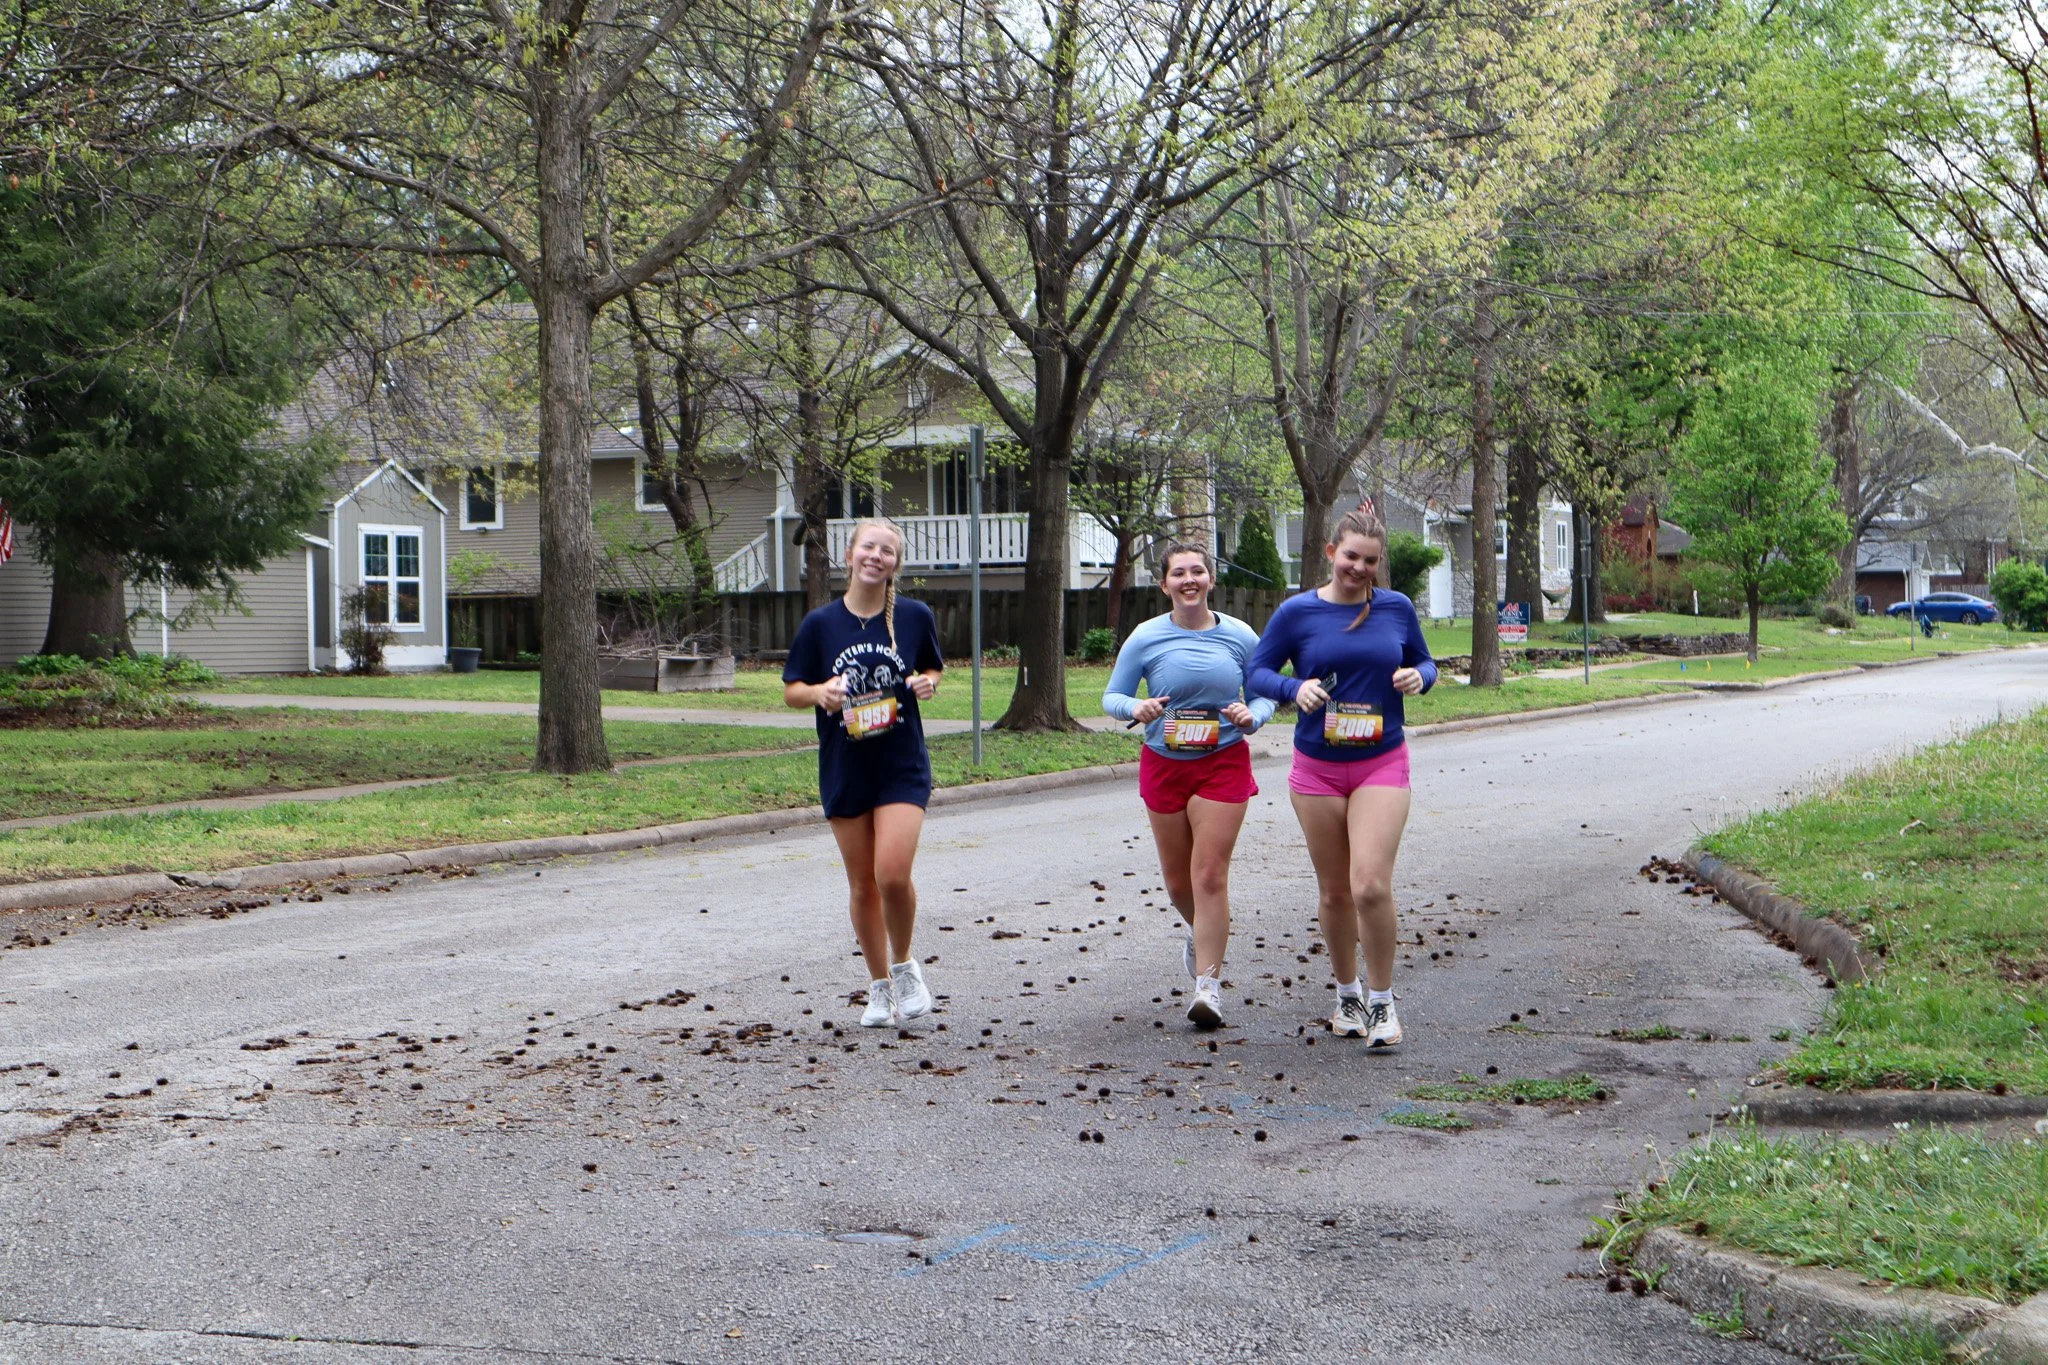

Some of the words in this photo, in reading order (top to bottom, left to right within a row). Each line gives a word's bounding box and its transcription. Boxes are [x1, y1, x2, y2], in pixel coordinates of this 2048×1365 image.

[832, 643, 872, 675] POTTER'S
[875, 643, 906, 672] HOUSE
[1174, 723, 1212, 742] 2007
[1336, 717, 1376, 738] 2006
